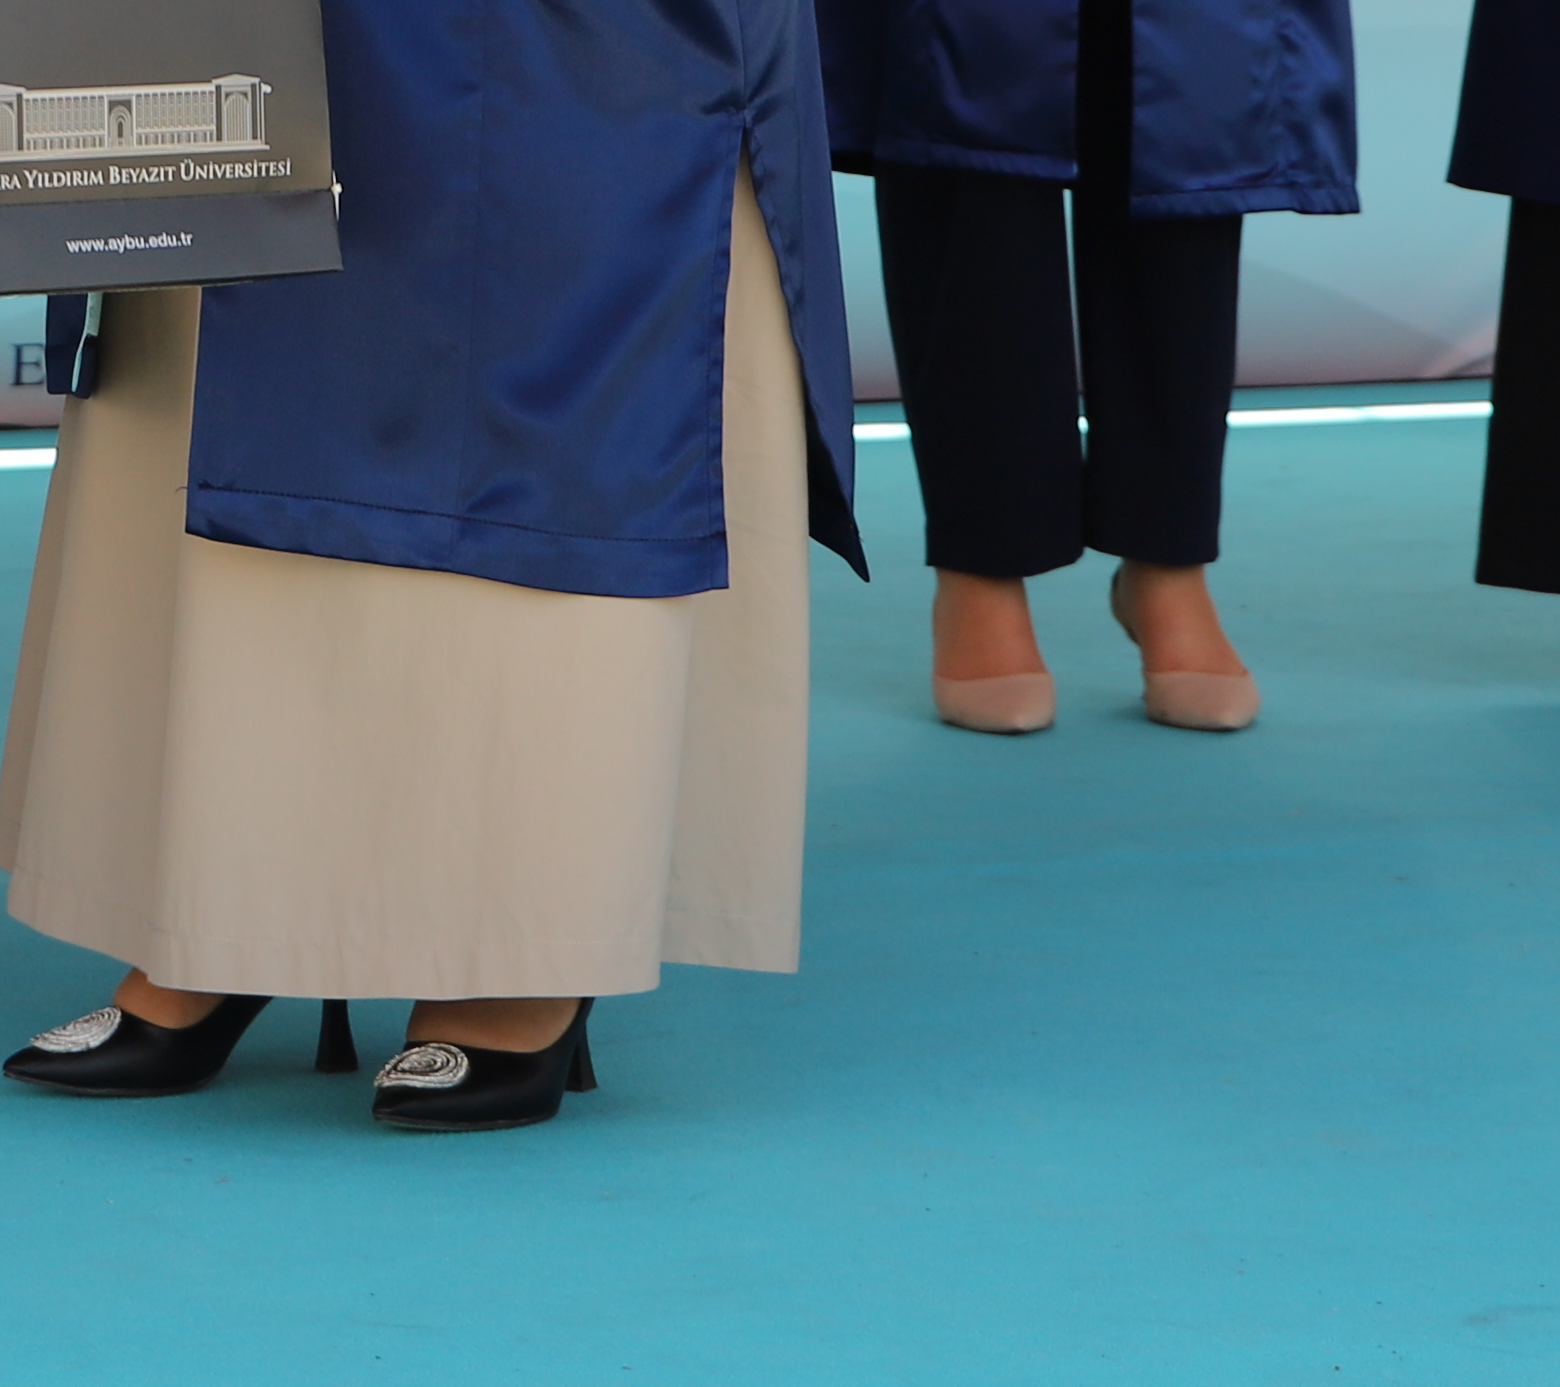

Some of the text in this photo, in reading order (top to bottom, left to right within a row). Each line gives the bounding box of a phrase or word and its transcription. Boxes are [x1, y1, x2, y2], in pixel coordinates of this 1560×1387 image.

[23, 168, 105, 190] YILDIRIM
[108, 164, 177, 186] BEYAZIT
[180, 157, 293, 182] ÜNİVERSİTESİ
[66, 230, 194, 254] www.aybu.edu.tr
